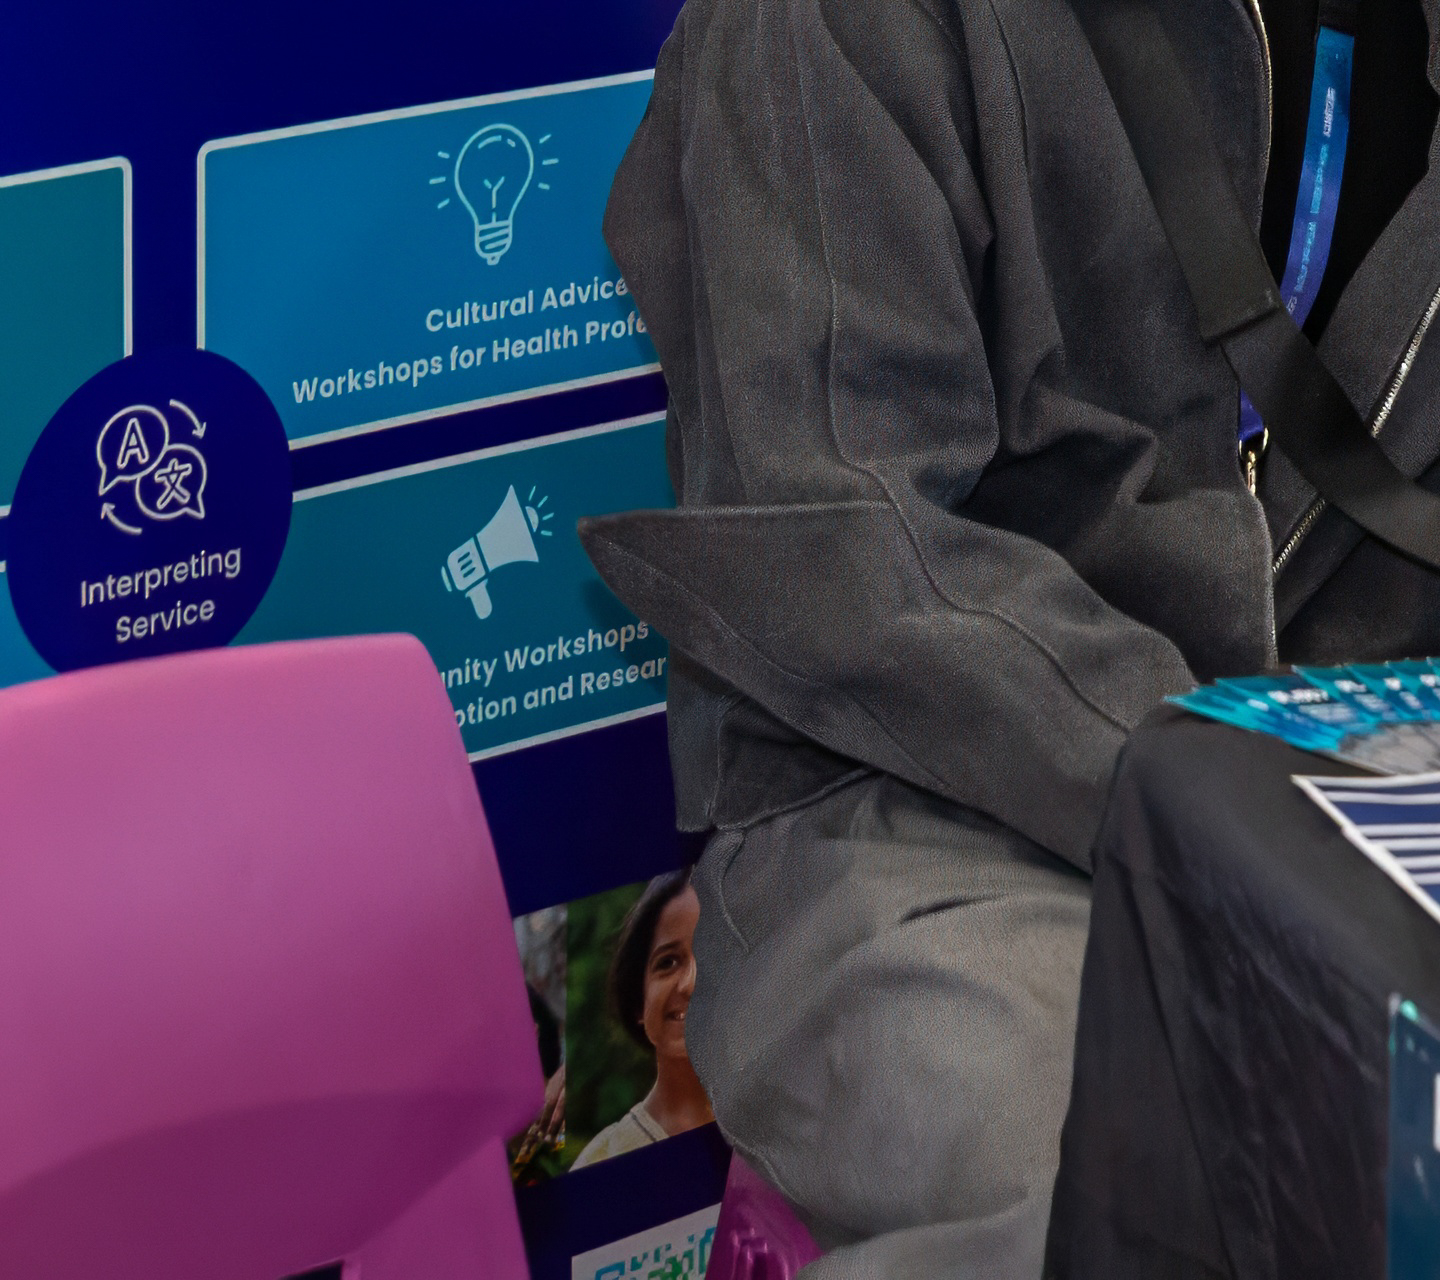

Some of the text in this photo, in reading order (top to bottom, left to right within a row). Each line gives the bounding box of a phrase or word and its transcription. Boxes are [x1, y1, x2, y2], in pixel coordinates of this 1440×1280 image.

[425, 274, 629, 334] Cultural Advice
[292, 326, 579, 406] Workshops for Health
[80, 546, 242, 609] Interpreting
[115, 596, 216, 644] Service
[503, 618, 650, 673] Workshops
[523, 677, 573, 713] and
